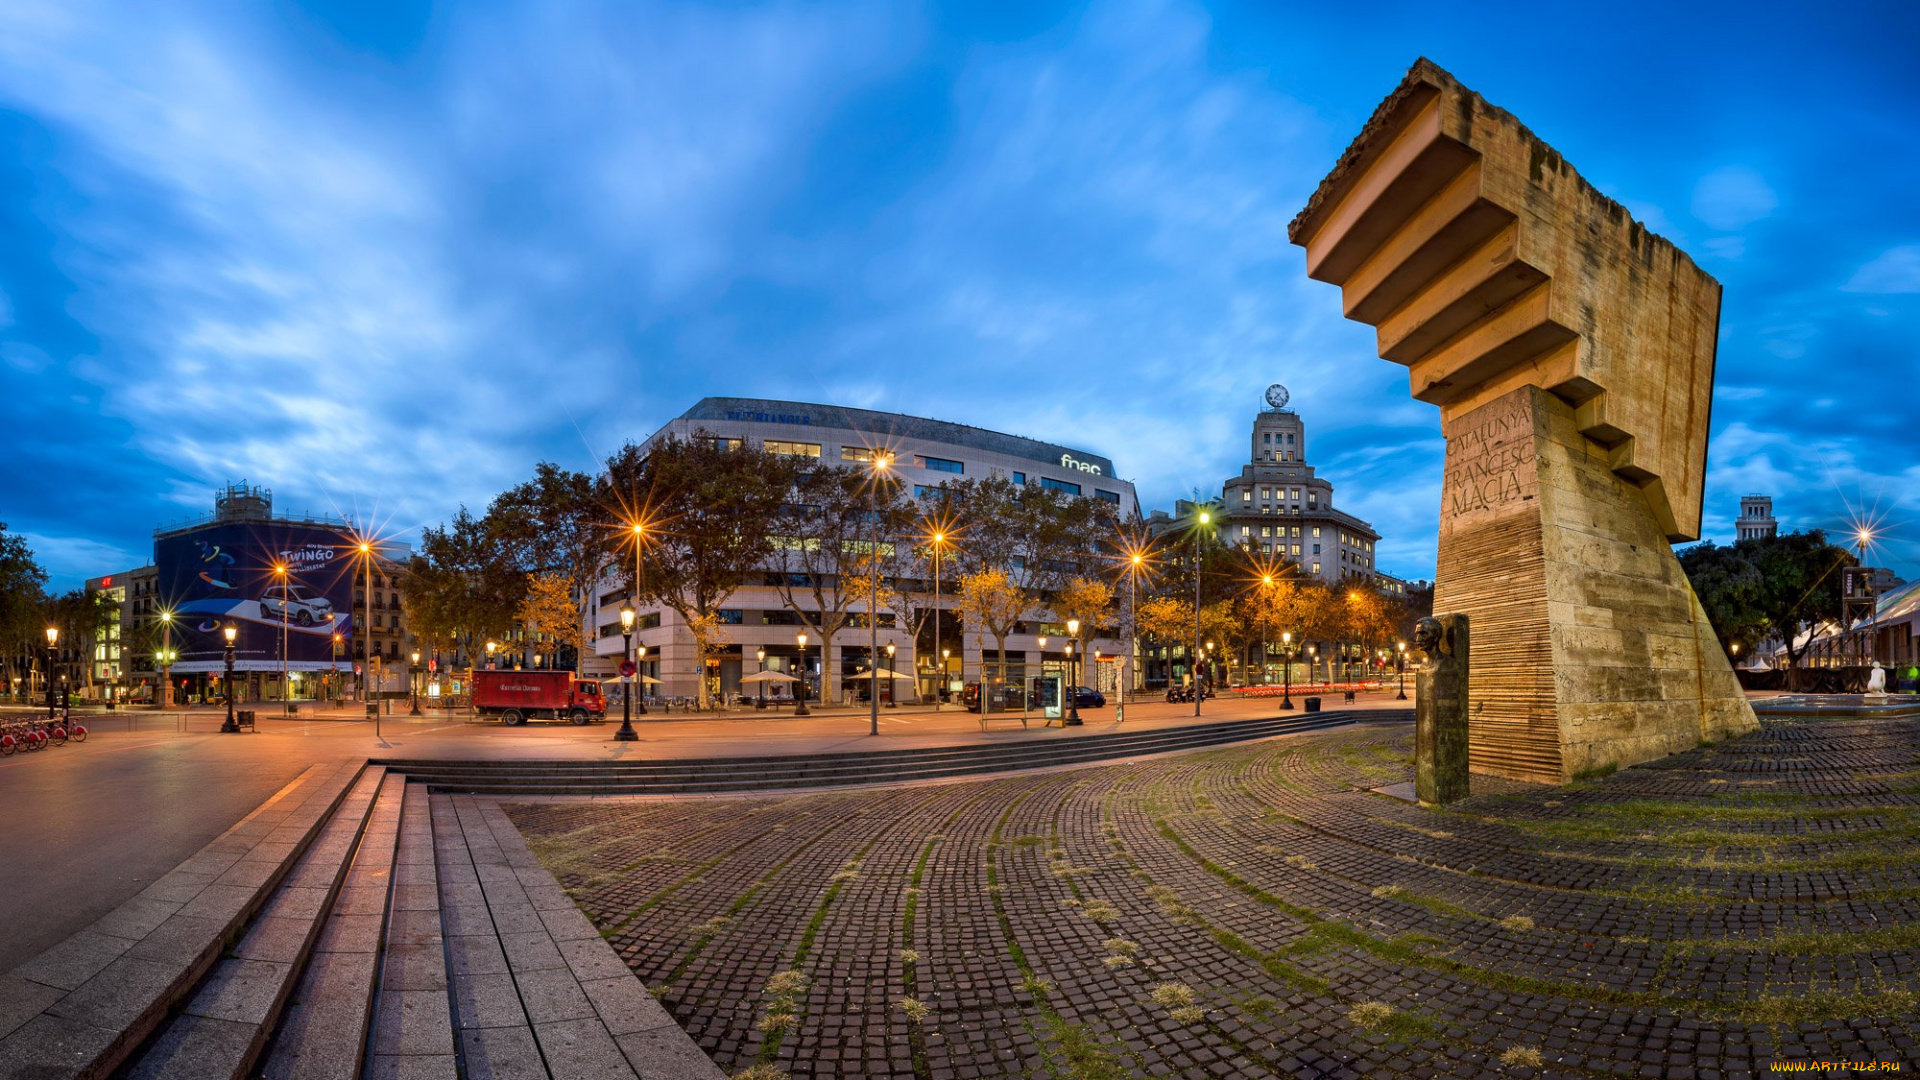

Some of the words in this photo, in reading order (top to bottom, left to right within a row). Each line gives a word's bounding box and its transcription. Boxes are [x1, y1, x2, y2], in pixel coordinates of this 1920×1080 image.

[1446, 407, 1530, 457] CATALUNYA
[1480, 441, 1490, 456] A
[1061, 454, 1101, 476] fnac
[1445, 441, 1534, 494] FRANCESC
